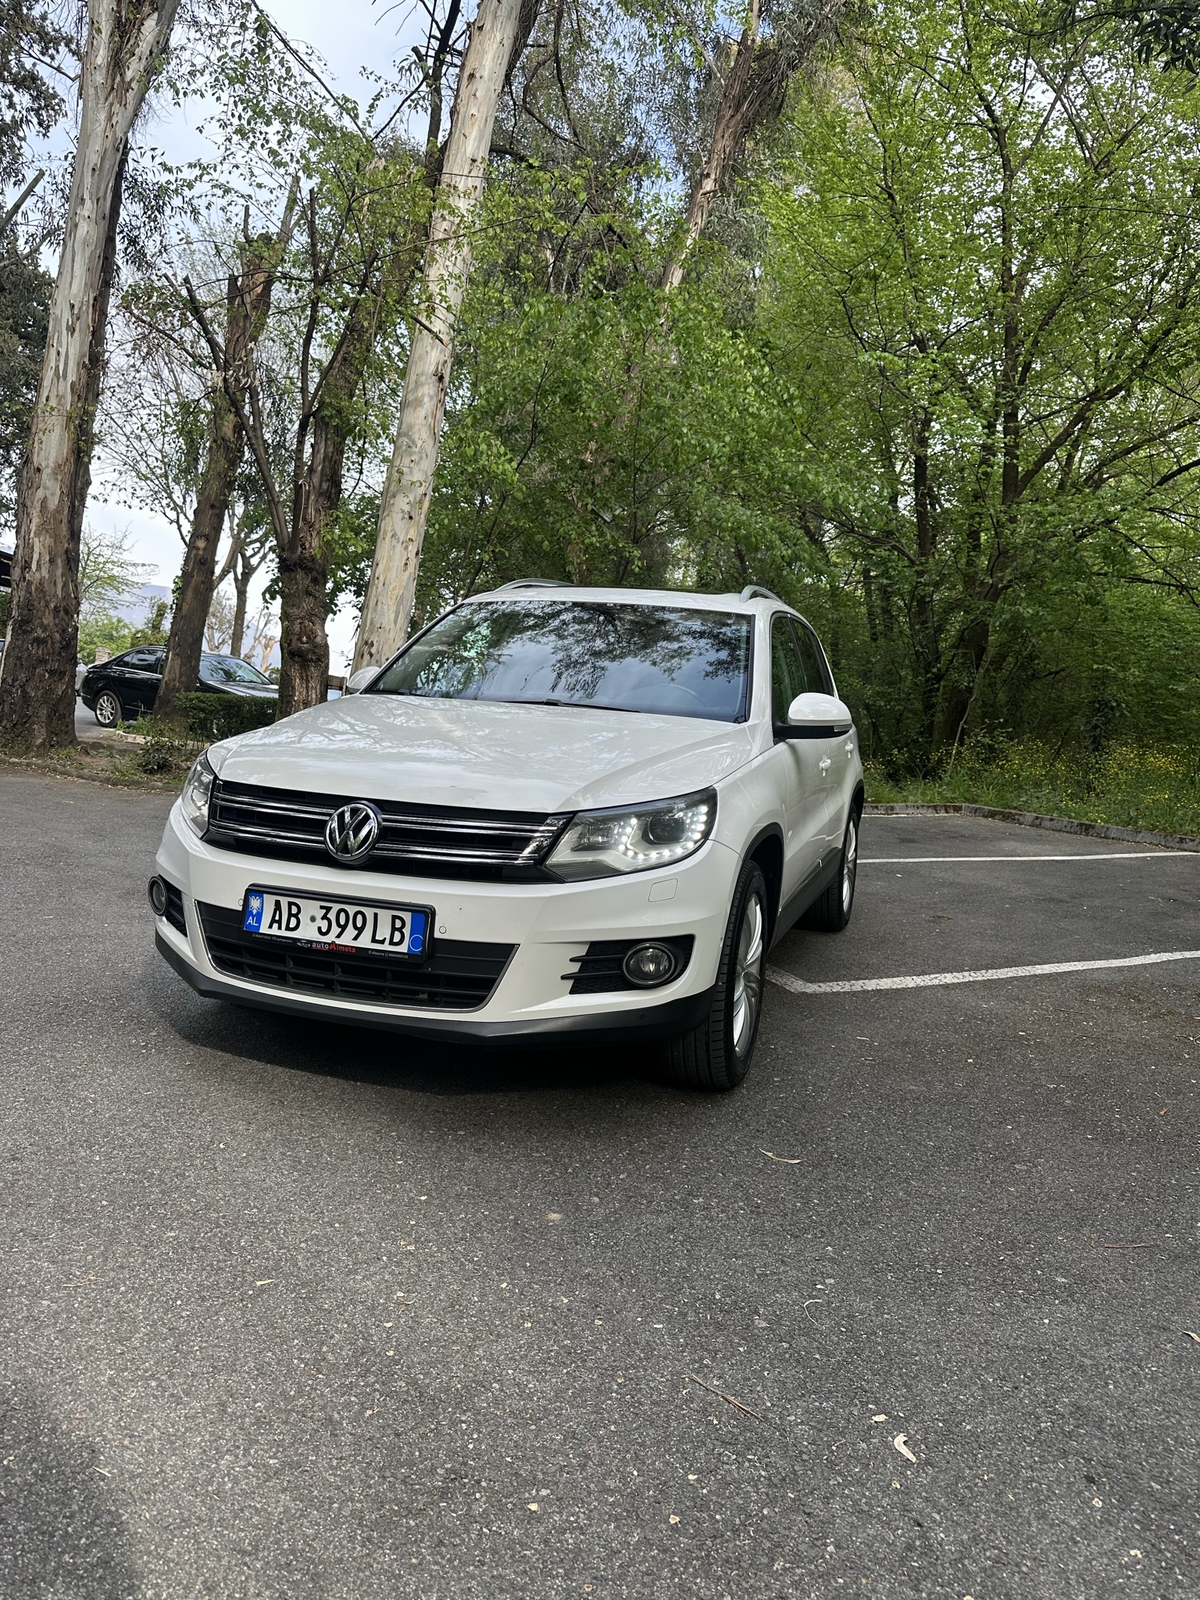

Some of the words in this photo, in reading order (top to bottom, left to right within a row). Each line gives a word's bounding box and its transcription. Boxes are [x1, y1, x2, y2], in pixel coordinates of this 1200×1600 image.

[246, 916, 259, 926] AL
[268, 899, 302, 932] AB
[317, 905, 406, 947] 399LB
